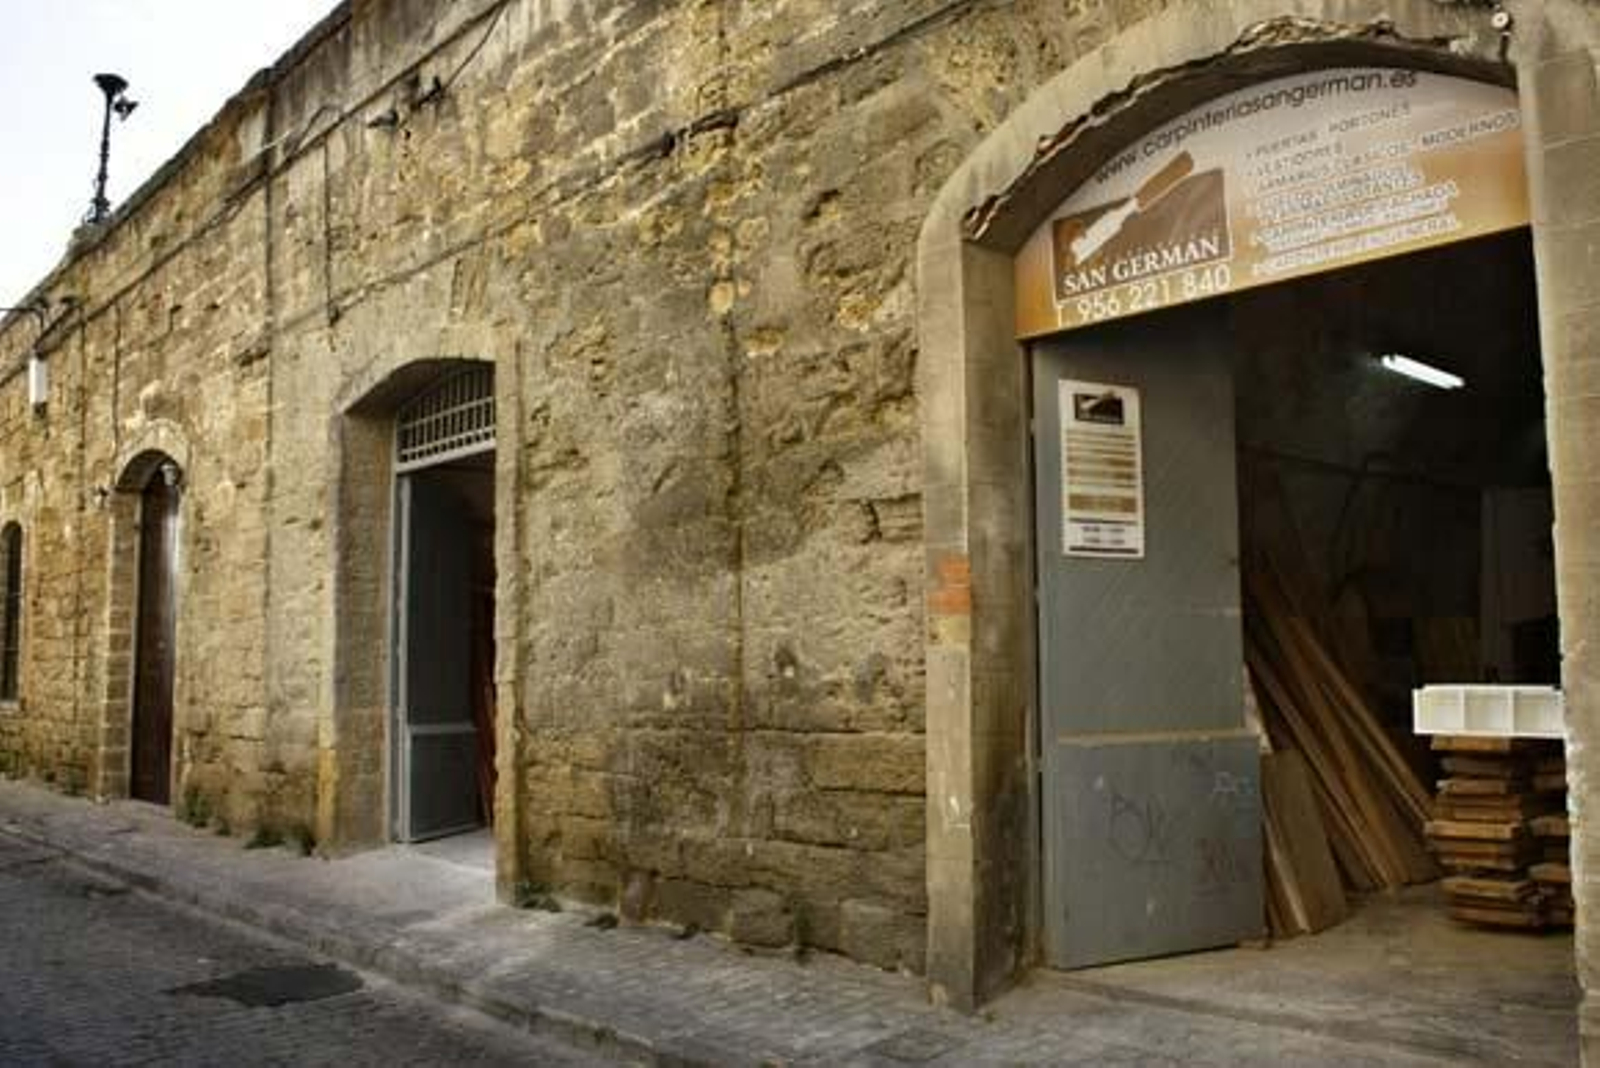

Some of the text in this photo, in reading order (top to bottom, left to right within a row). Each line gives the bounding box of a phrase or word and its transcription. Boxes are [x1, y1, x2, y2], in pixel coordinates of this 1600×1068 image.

[1095, 69, 1418, 184] www.carpinteriasangerman.es
[1064, 264, 1107, 294] SAN
[1077, 289, 1120, 322] 956
[1129, 278, 1171, 312] 221
[1182, 262, 1232, 301] 840
